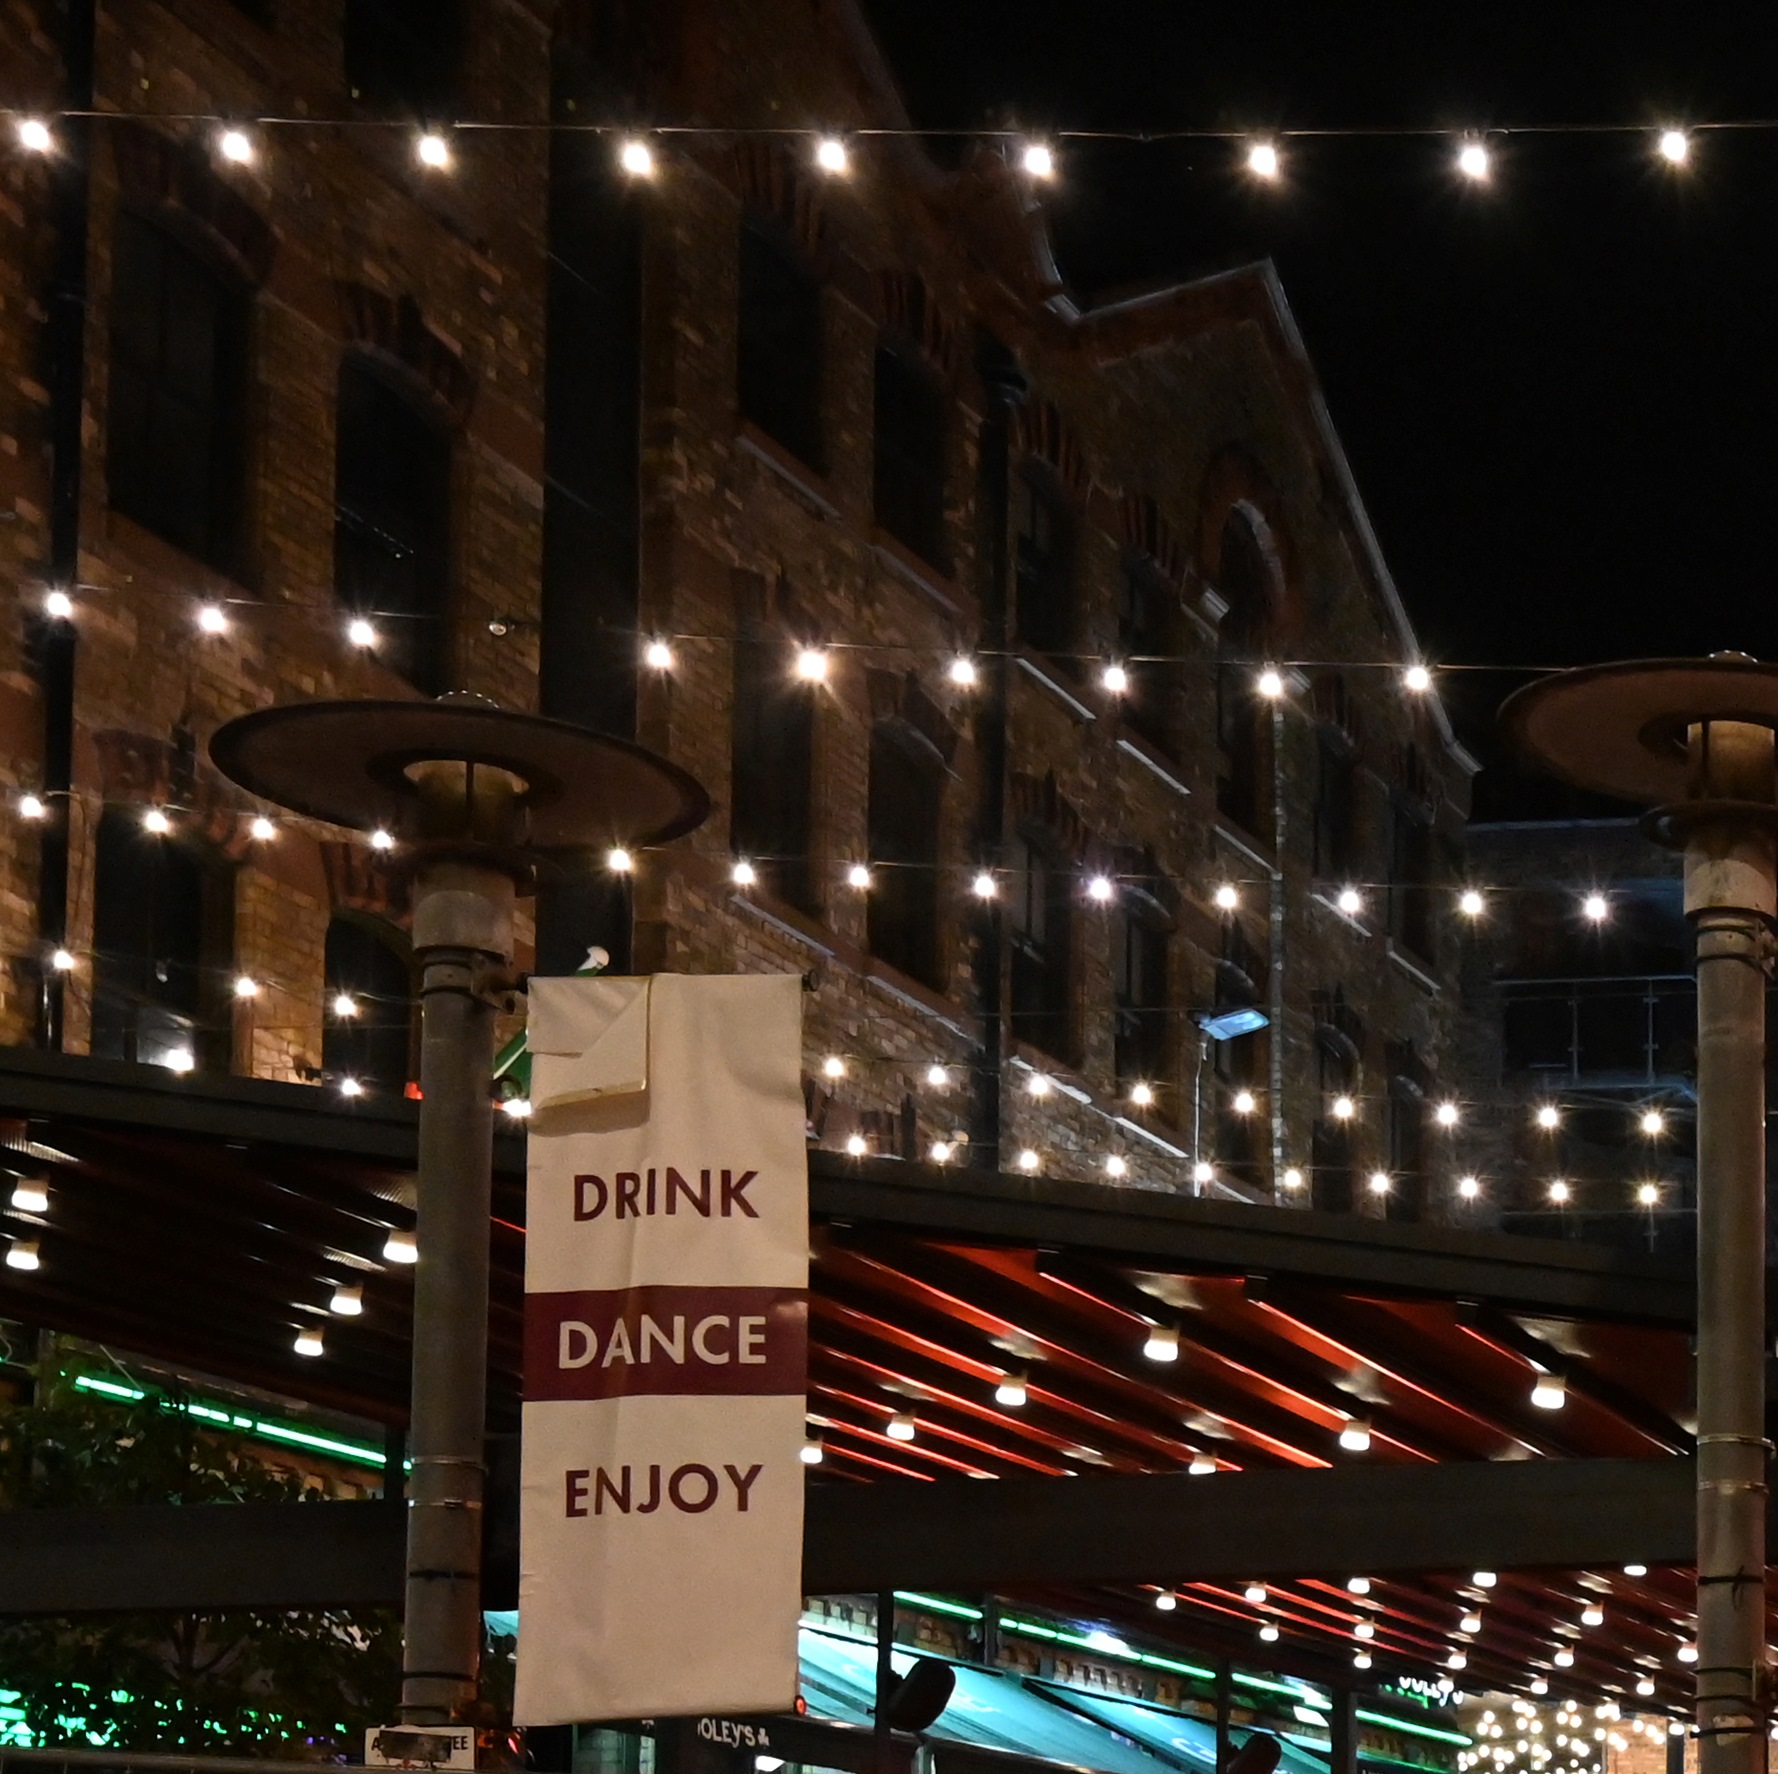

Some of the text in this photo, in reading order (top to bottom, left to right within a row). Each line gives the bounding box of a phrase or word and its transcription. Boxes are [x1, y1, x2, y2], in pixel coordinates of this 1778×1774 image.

[572, 1166, 760, 1222] DRINK
[558, 1314, 767, 1370] DANCE
[565, 1463, 763, 1518] ENJOY
[698, 1717, 756, 1748] OLEY'S
